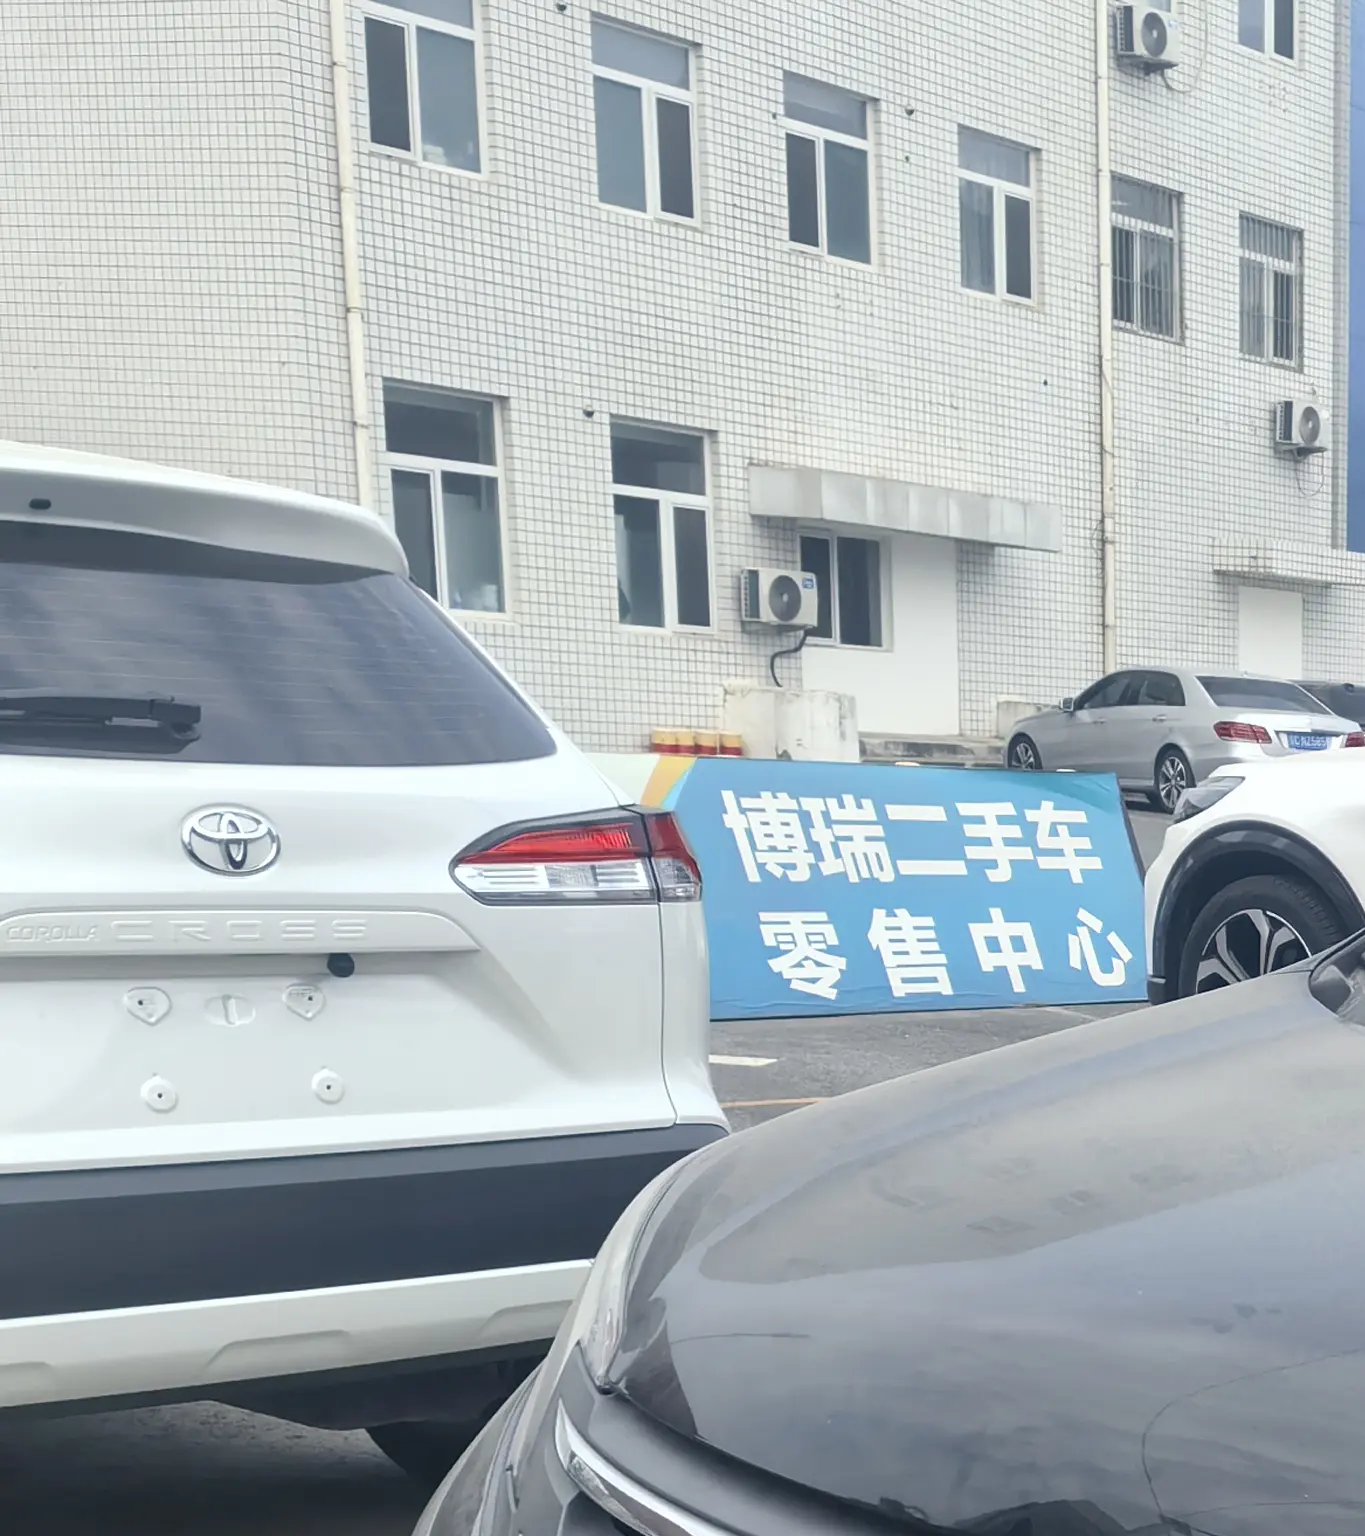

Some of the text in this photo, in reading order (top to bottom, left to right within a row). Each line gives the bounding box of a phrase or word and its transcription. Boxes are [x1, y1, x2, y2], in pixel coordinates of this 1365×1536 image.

[721, 790, 1104, 884] 博瑞二手车
[6, 918, 368, 943] COROLLA CROSS
[758, 907, 1134, 1000] 零售中心
